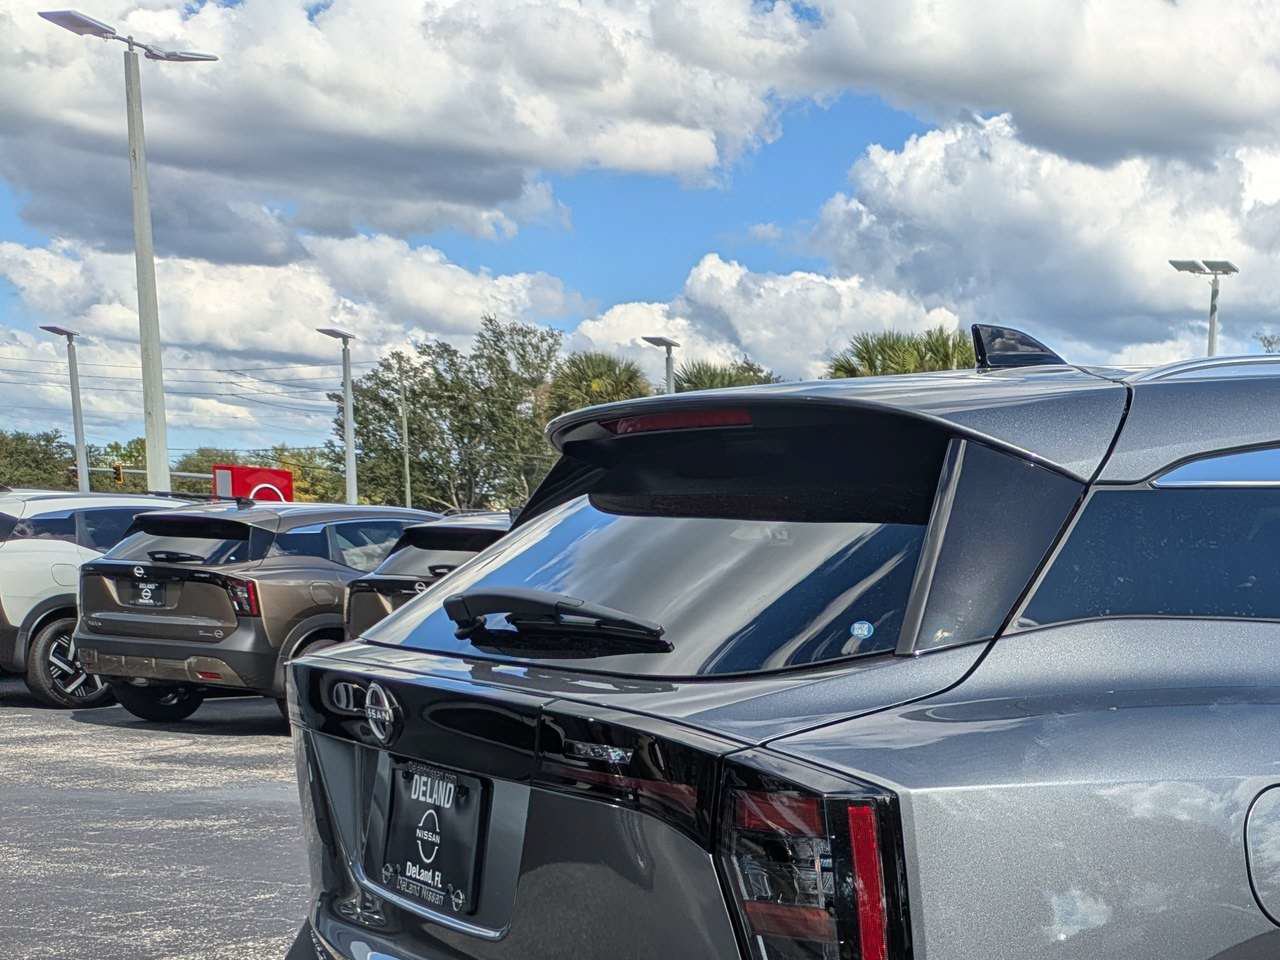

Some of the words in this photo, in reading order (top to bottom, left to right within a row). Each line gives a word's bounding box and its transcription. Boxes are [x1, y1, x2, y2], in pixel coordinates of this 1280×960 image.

[411, 774, 454, 809] DELAND
[416, 828, 441, 844] NISSAN
[405, 861, 434, 885] DeLand,
[434, 868, 442, 888] FL
